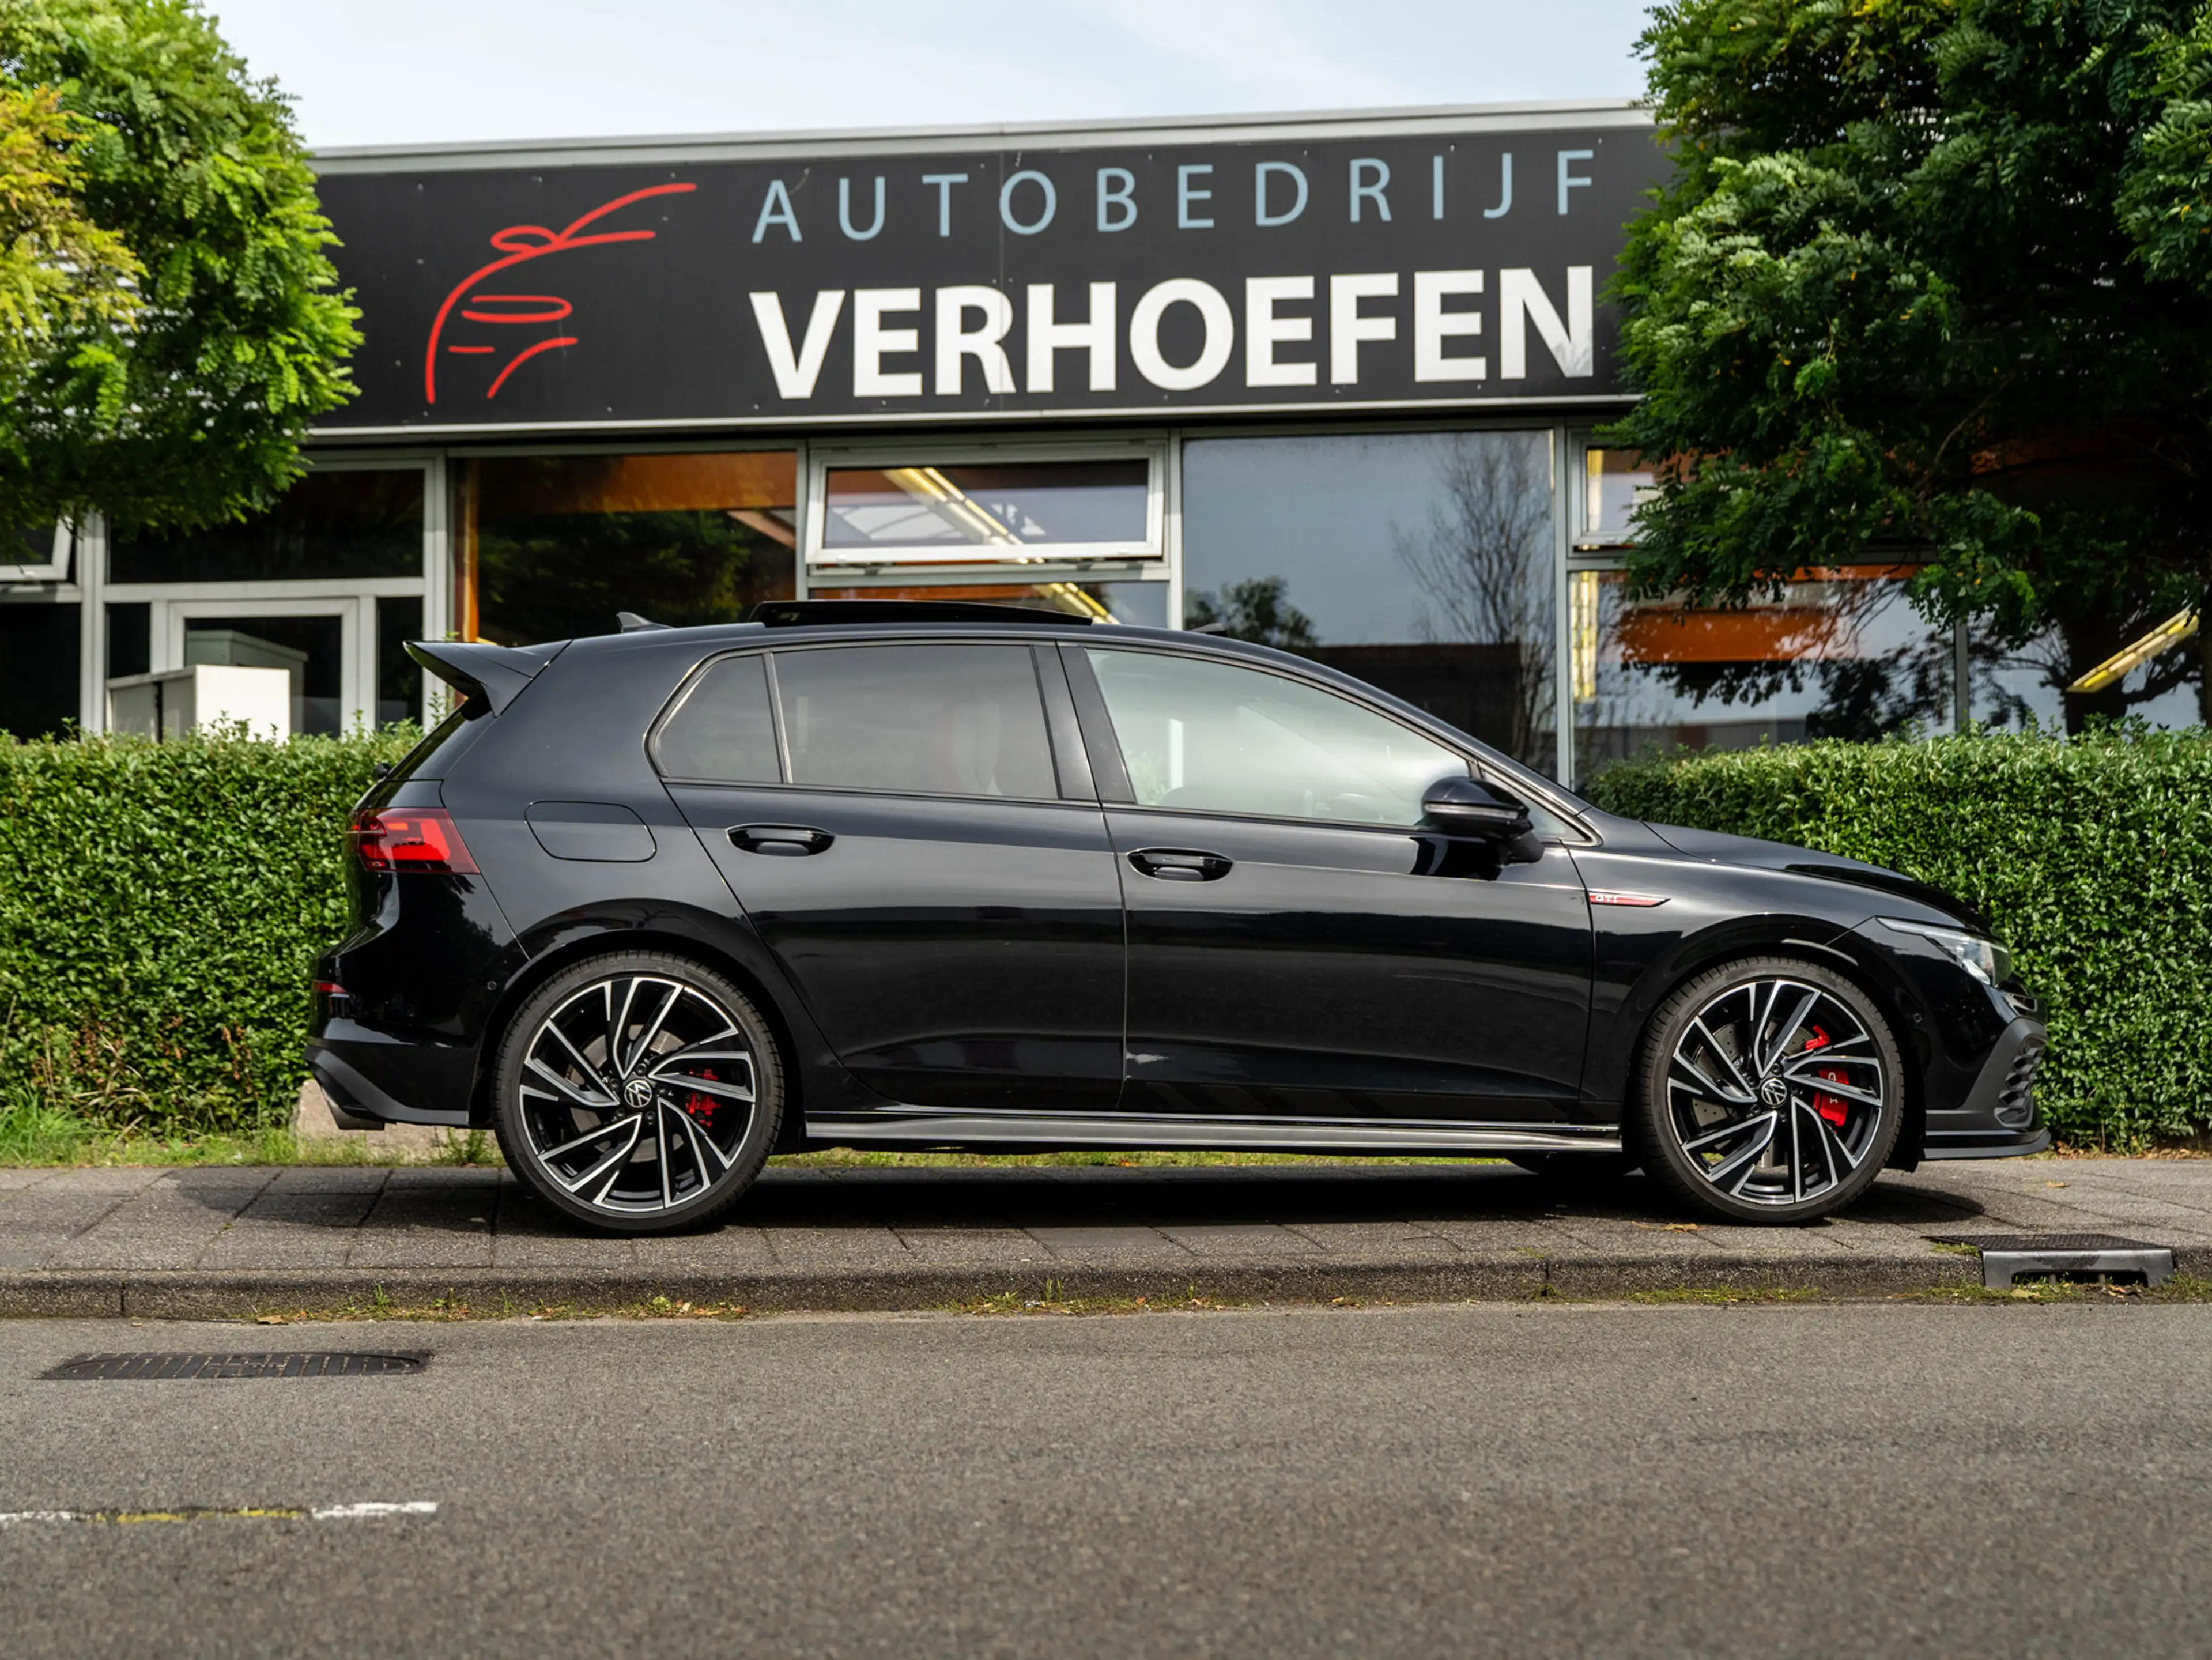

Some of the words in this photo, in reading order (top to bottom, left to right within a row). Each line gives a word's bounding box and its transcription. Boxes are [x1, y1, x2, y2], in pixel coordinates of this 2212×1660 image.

[752, 150, 1594, 242] AUTOBEDRIJF
[749, 266, 1592, 398] VERHOEFEN
[1595, 895, 1618, 903] GTI
